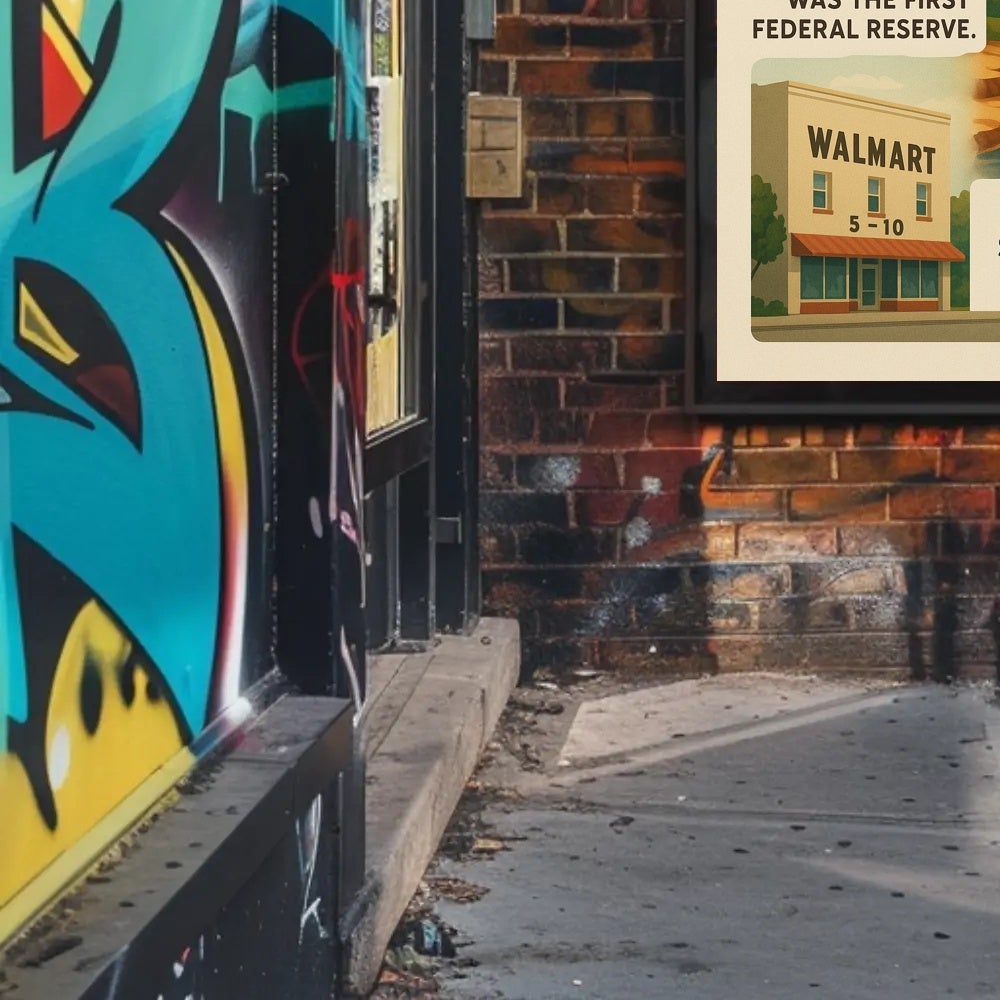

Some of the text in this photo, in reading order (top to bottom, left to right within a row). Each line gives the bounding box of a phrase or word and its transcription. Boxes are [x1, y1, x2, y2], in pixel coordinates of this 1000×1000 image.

[753, 19, 976, 39] FEDERAL RESERVE.
[808, 125, 936, 174] WALMART
